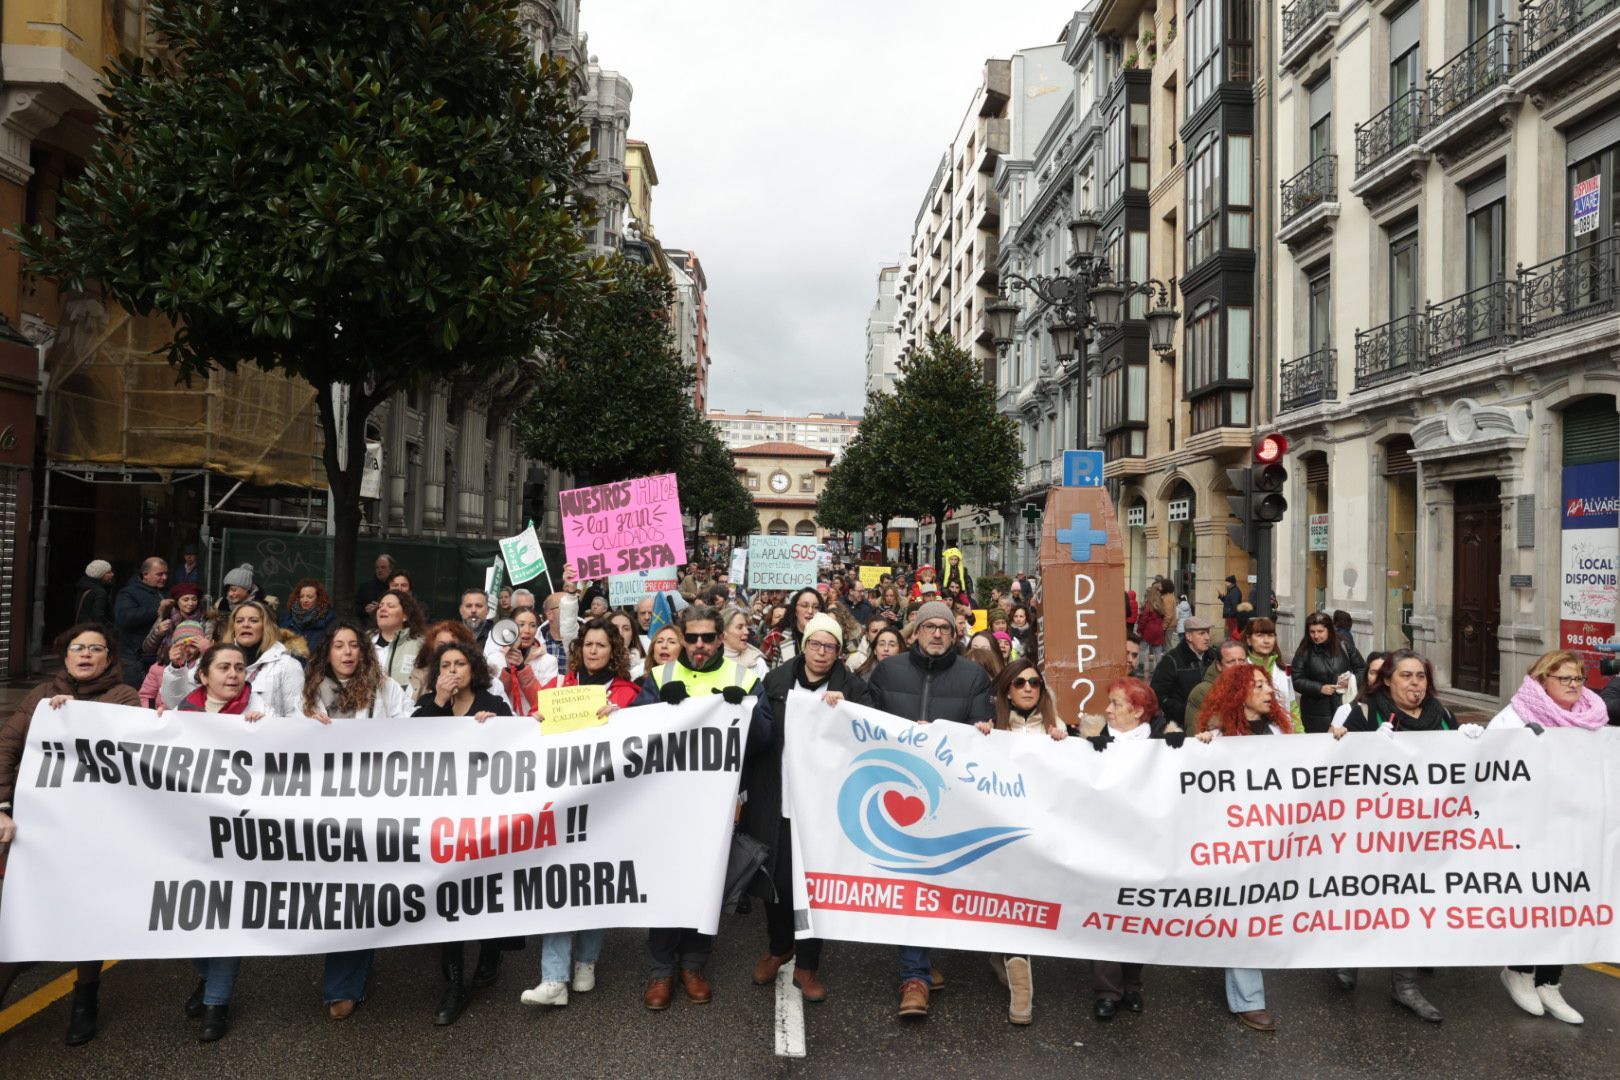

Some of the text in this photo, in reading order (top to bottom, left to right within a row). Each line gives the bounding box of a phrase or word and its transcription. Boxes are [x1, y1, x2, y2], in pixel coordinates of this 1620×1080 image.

[1072, 457, 1094, 485] P
[561, 482, 631, 517] NUESTROS
[1583, 500, 1619, 513] ALVARE
[577, 543, 675, 578] DEL SESPA
[1579, 558, 1613, 570] LOCAL
[753, 572, 813, 585] DERECHOS
[1566, 573, 1616, 585] DISPONIB
[1567, 634, 1584, 645] 985
[1586, 636, 1604, 647] 089
[551, 694, 591, 705] PRIMARIA
[73, 738, 253, 795] ASTURIES
[261, 752, 312, 797] NA
[321, 751, 457, 797] LLUCHA
[466, 750, 536, 796] POR
[546, 740, 615, 789] UNA
[622, 718, 741, 779] SANIDÁ
[851, 718, 1027, 798] Ola de la Salud
[1180, 759, 1531, 794] POR LA DEFENSA DE UNA
[1226, 791, 1480, 827] SANIDAD PÚBLICA,
[209, 801, 588, 864] PÚBLICA DE CALIDÁ !!
[1190, 827, 1521, 866] GRATUÍTA Y UNIVERSAL.
[148, 860, 647, 931] NON DEIXEMOS QUE MORRA.
[806, 877, 1050, 925] CUIDARME ES CUIDARTE
[1117, 870, 1591, 908] ESTABILIDAD LABORAL PARA UNA
[1082, 904, 1614, 938] ATENCIÓN DE CALIDAD Y SEGURIDAD
